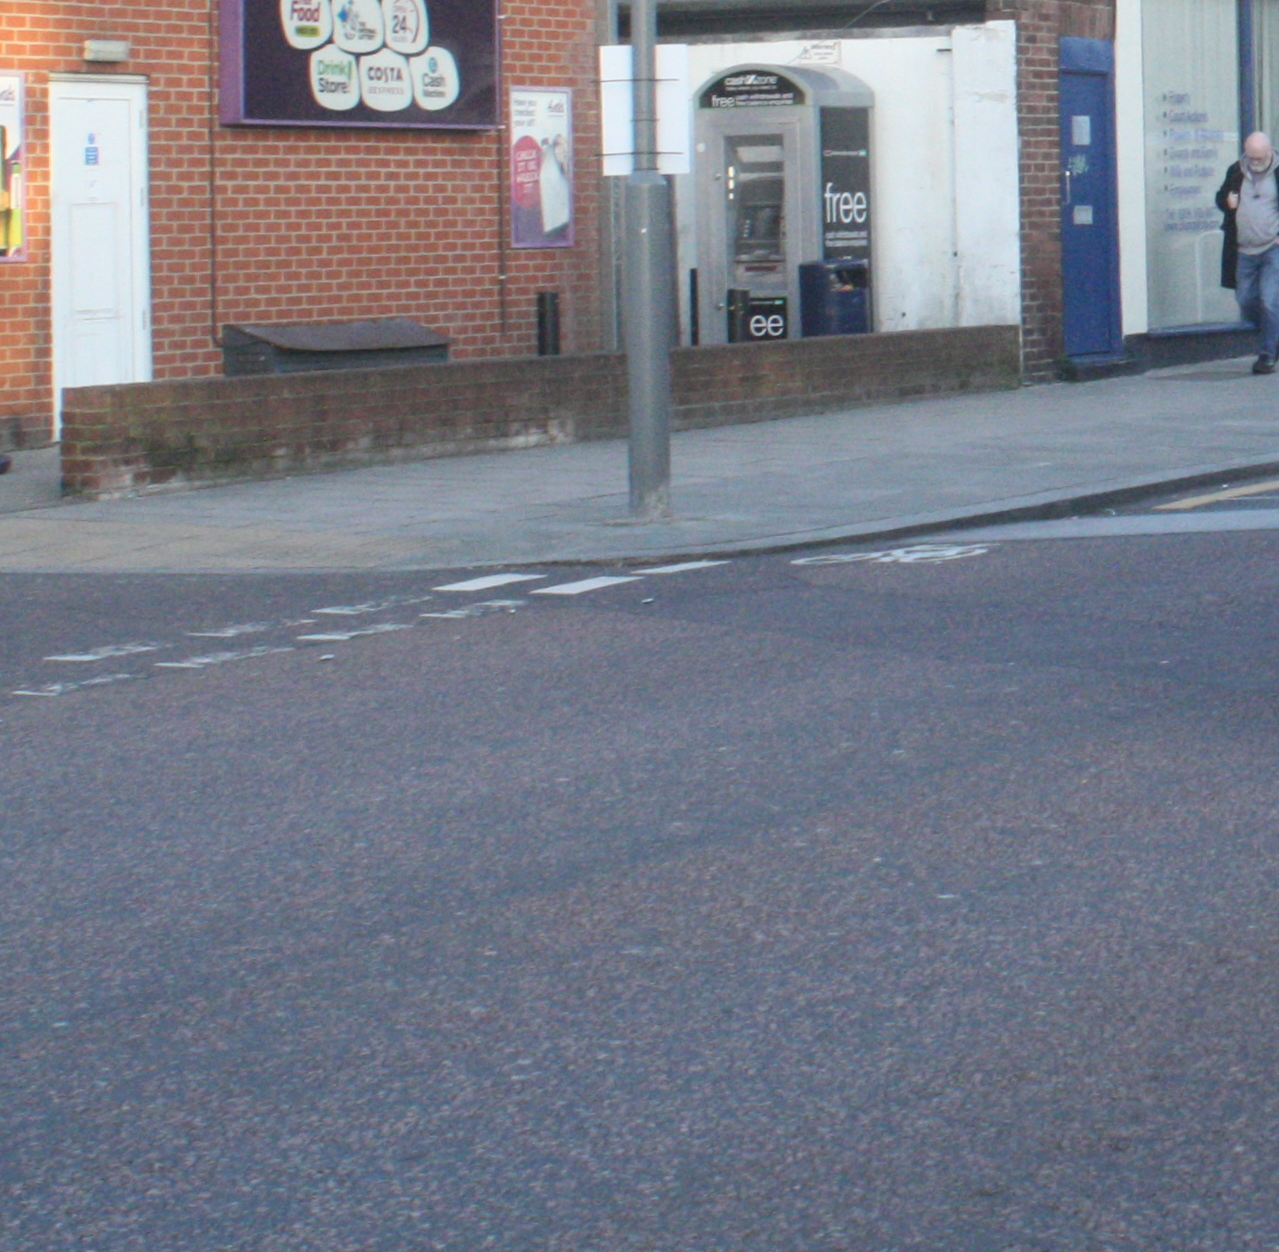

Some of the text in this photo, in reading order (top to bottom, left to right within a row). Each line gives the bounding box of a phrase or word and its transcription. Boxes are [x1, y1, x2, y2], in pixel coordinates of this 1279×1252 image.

[290, 0, 321, 23] Food
[393, 15, 407, 34] 24
[367, 67, 404, 83] COSTA
[711, 94, 735, 107] free
[823, 182, 867, 223] free
[750, 314, 784, 336] ee
